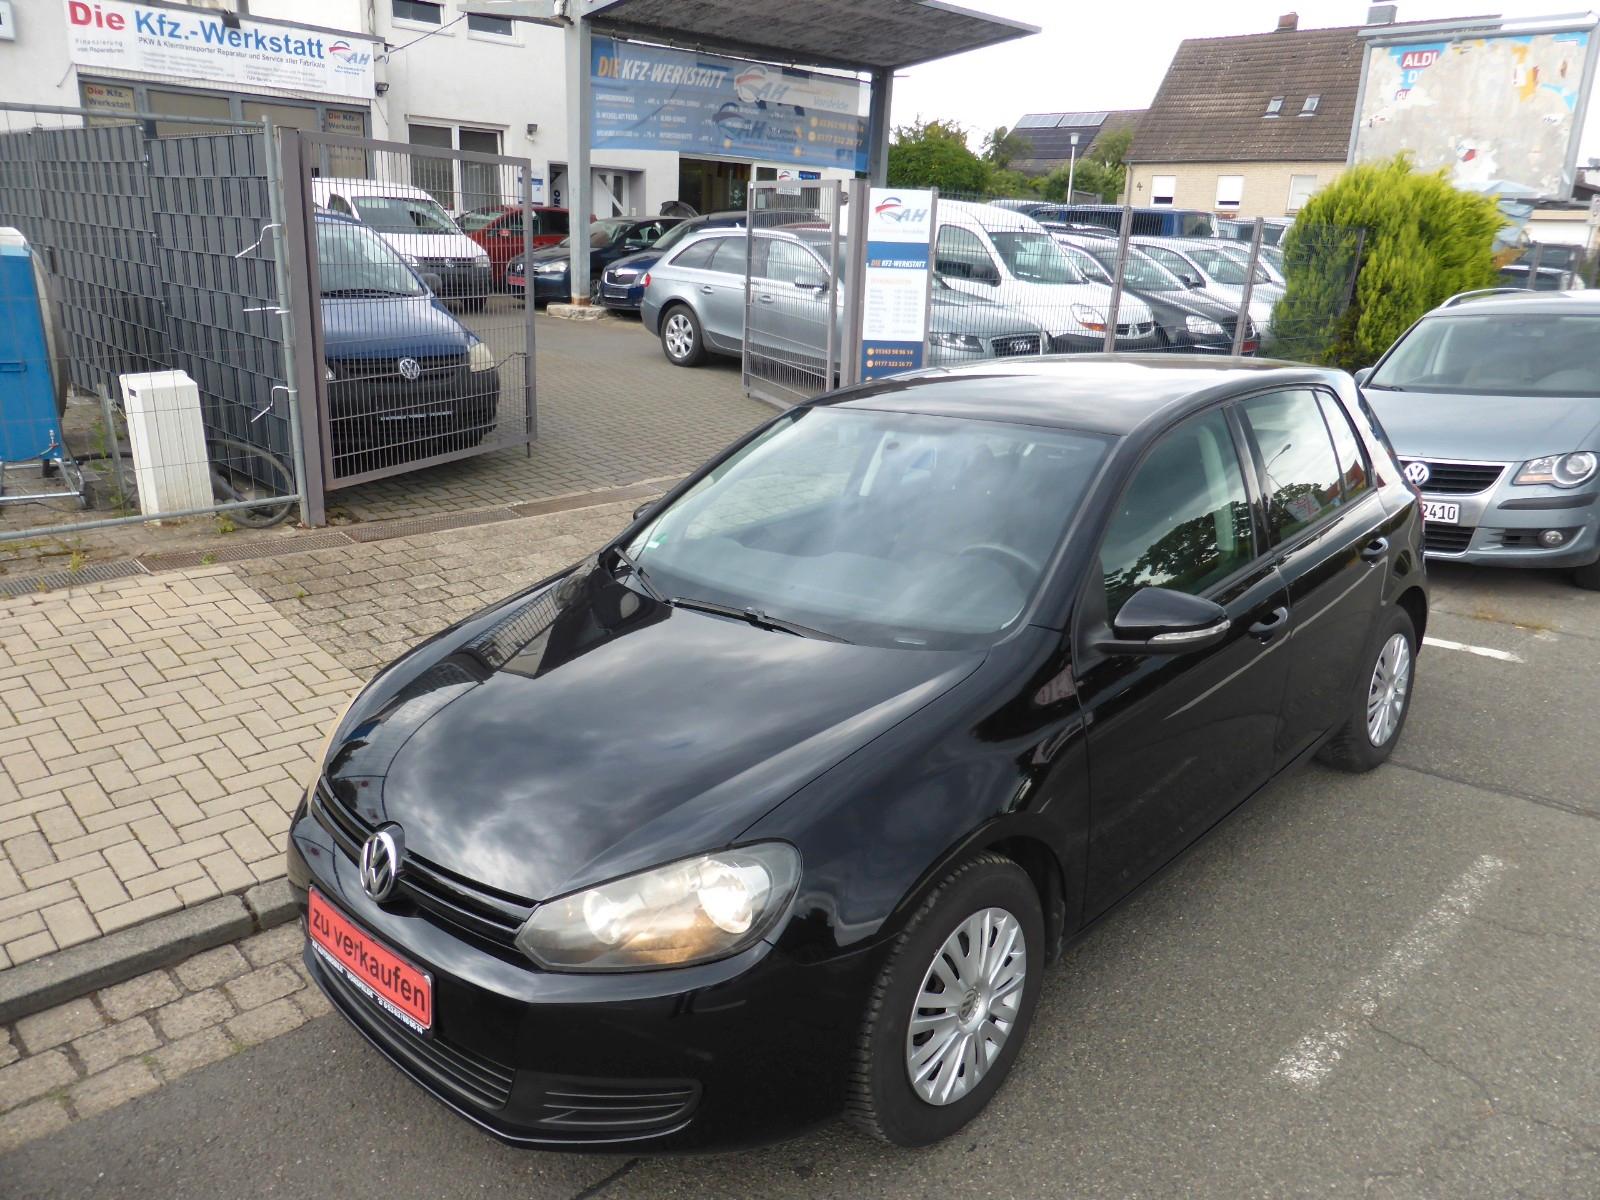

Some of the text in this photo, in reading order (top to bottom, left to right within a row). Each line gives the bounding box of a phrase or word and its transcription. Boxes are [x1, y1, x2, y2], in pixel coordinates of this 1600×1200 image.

[68, 1, 325, 60] Die Kfz.-Werkstatt
[138, 36, 155, 46] PKW
[164, 41, 216, 54] Kleintransporter
[217, 49, 247, 59] Reparatur
[261, 54, 284, 64] Service
[1402, 52, 1440, 67] ALDI
[597, 56, 726, 90] DIE KFZ-WERKSTATT
[899, 208, 928, 223] AH
[881, 260, 926, 268] KFZ-WERKSTATT
[1422, 504, 1456, 520] 2410
[313, 908, 425, 1012] zu verkaufen
